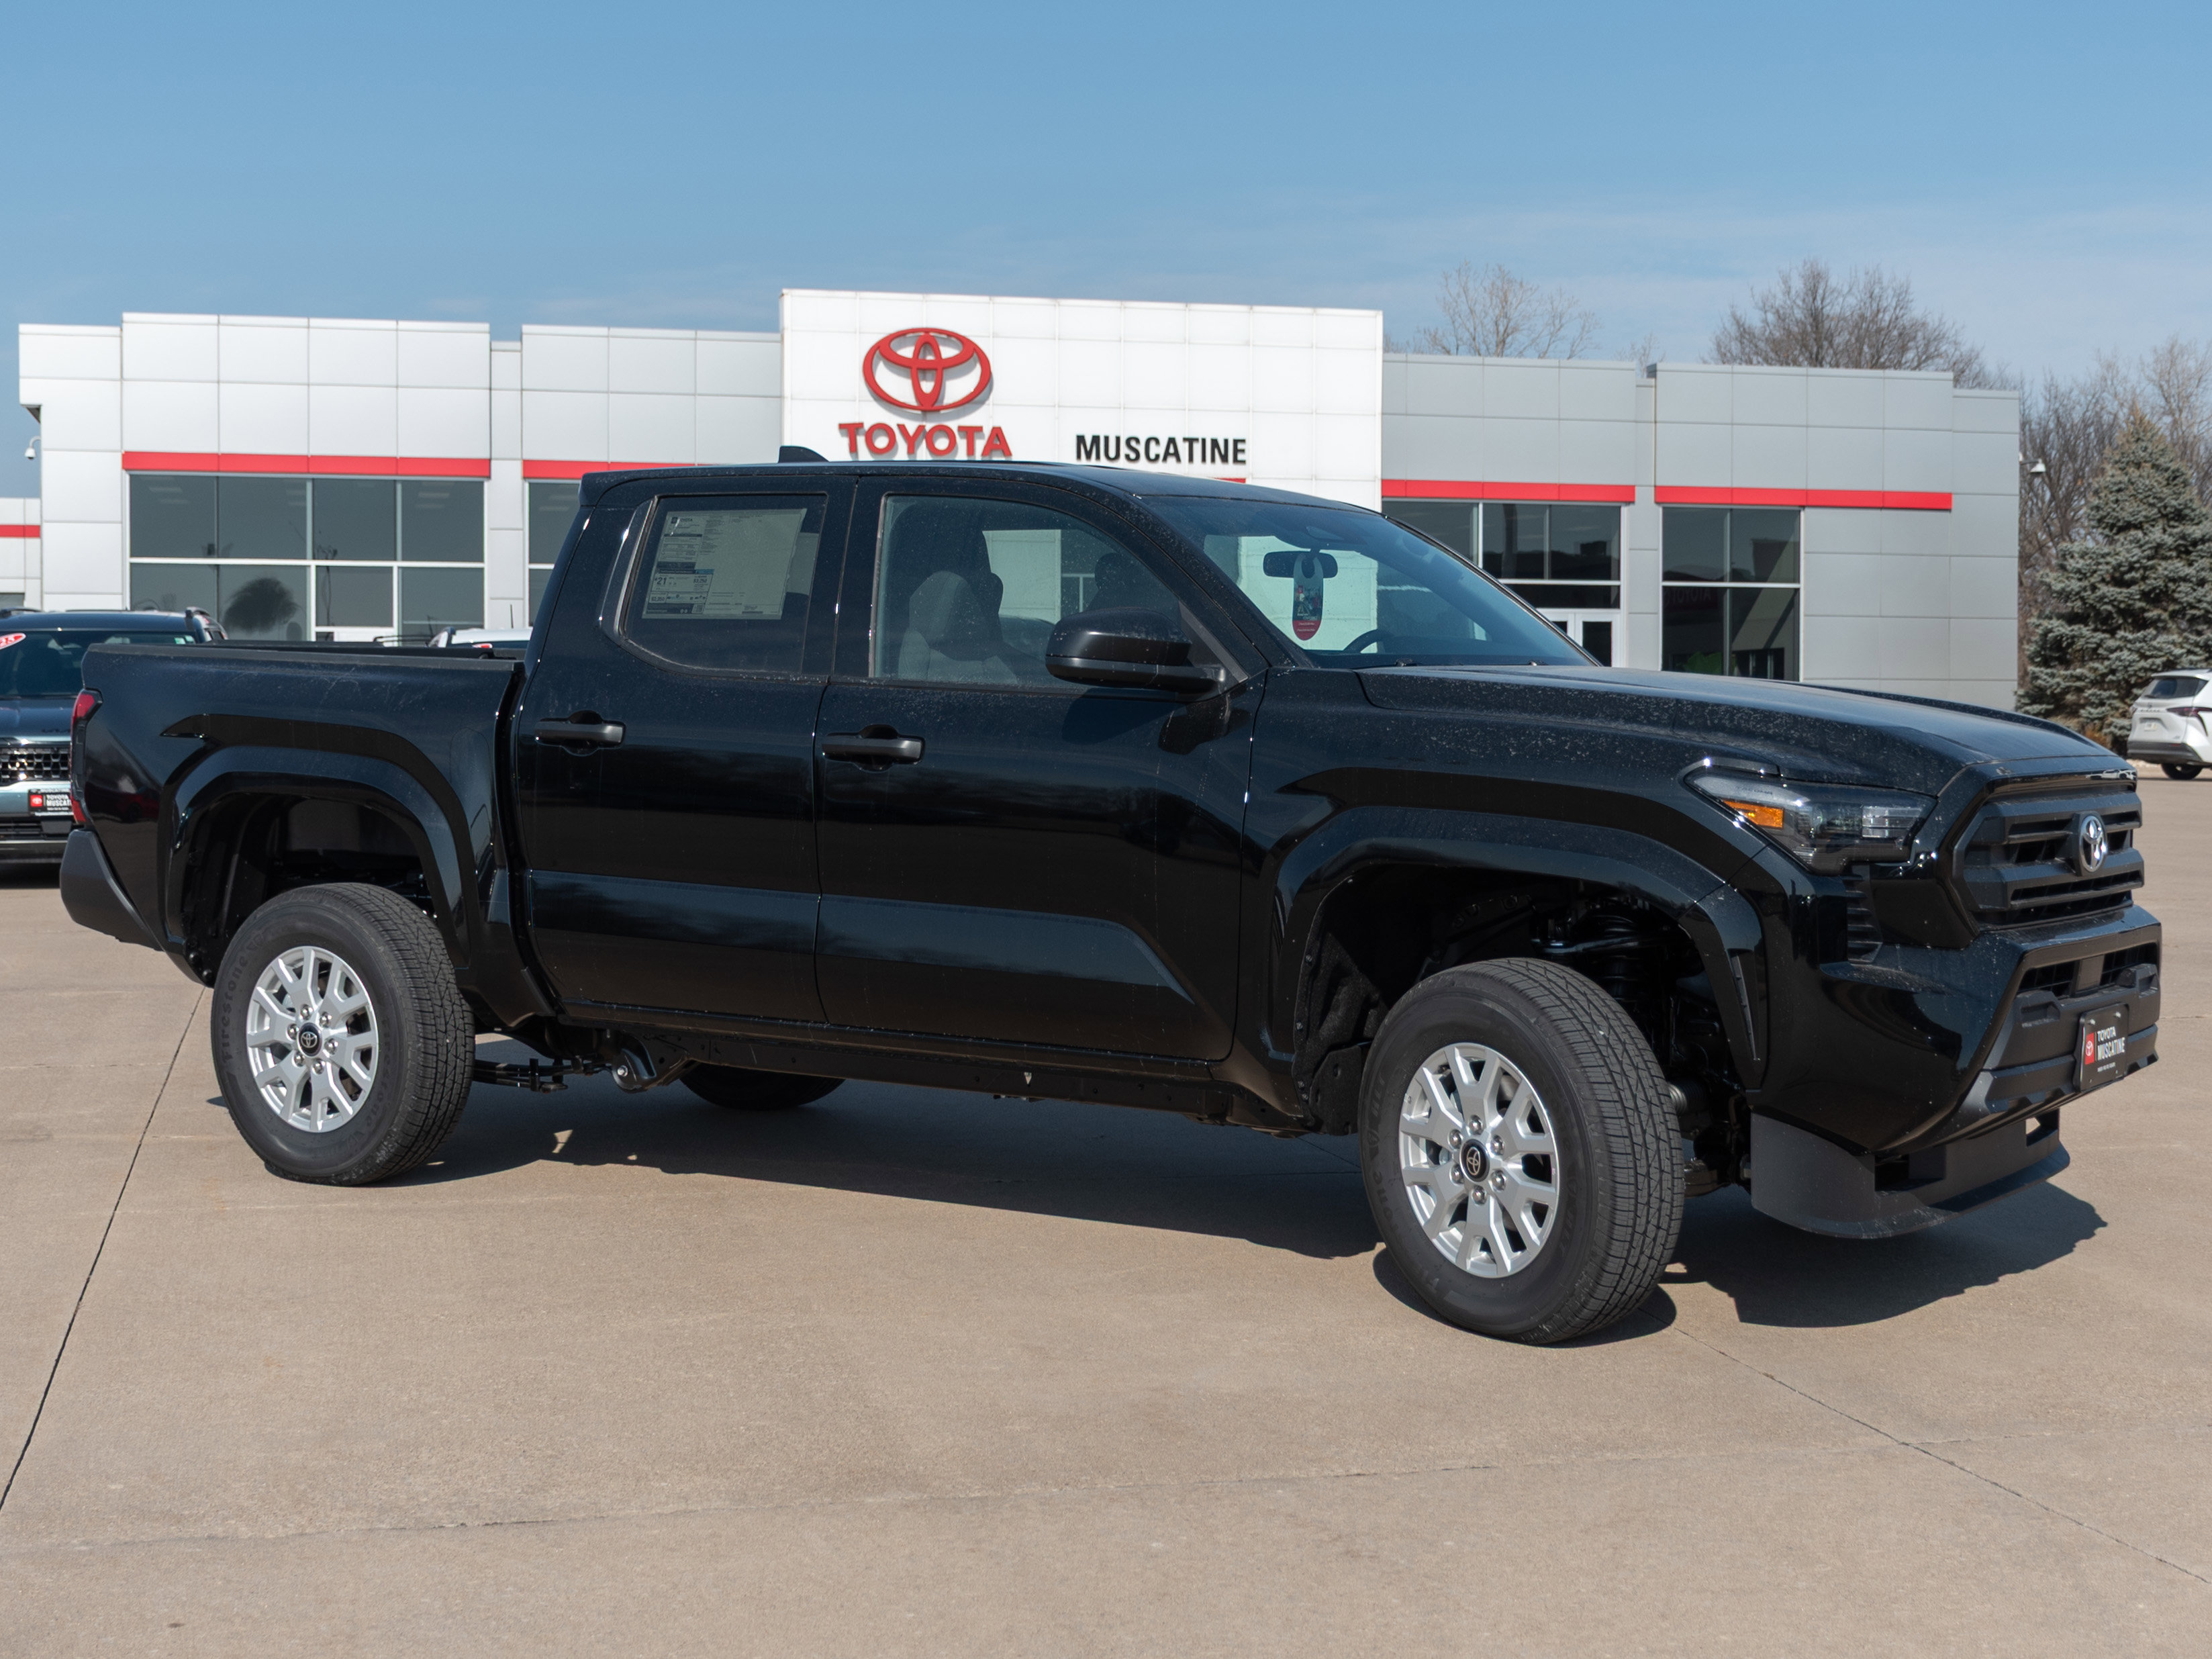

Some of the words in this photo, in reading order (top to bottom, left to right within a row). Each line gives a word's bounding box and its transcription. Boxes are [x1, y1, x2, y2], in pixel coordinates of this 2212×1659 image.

[838, 422, 1012, 457] TOYOTA
[1075, 434, 1246, 464] MUSCATINE
[2097, 1026, 2116, 1041] TOYOTA
[2097, 1037, 2125, 1061] MUSCATINE
